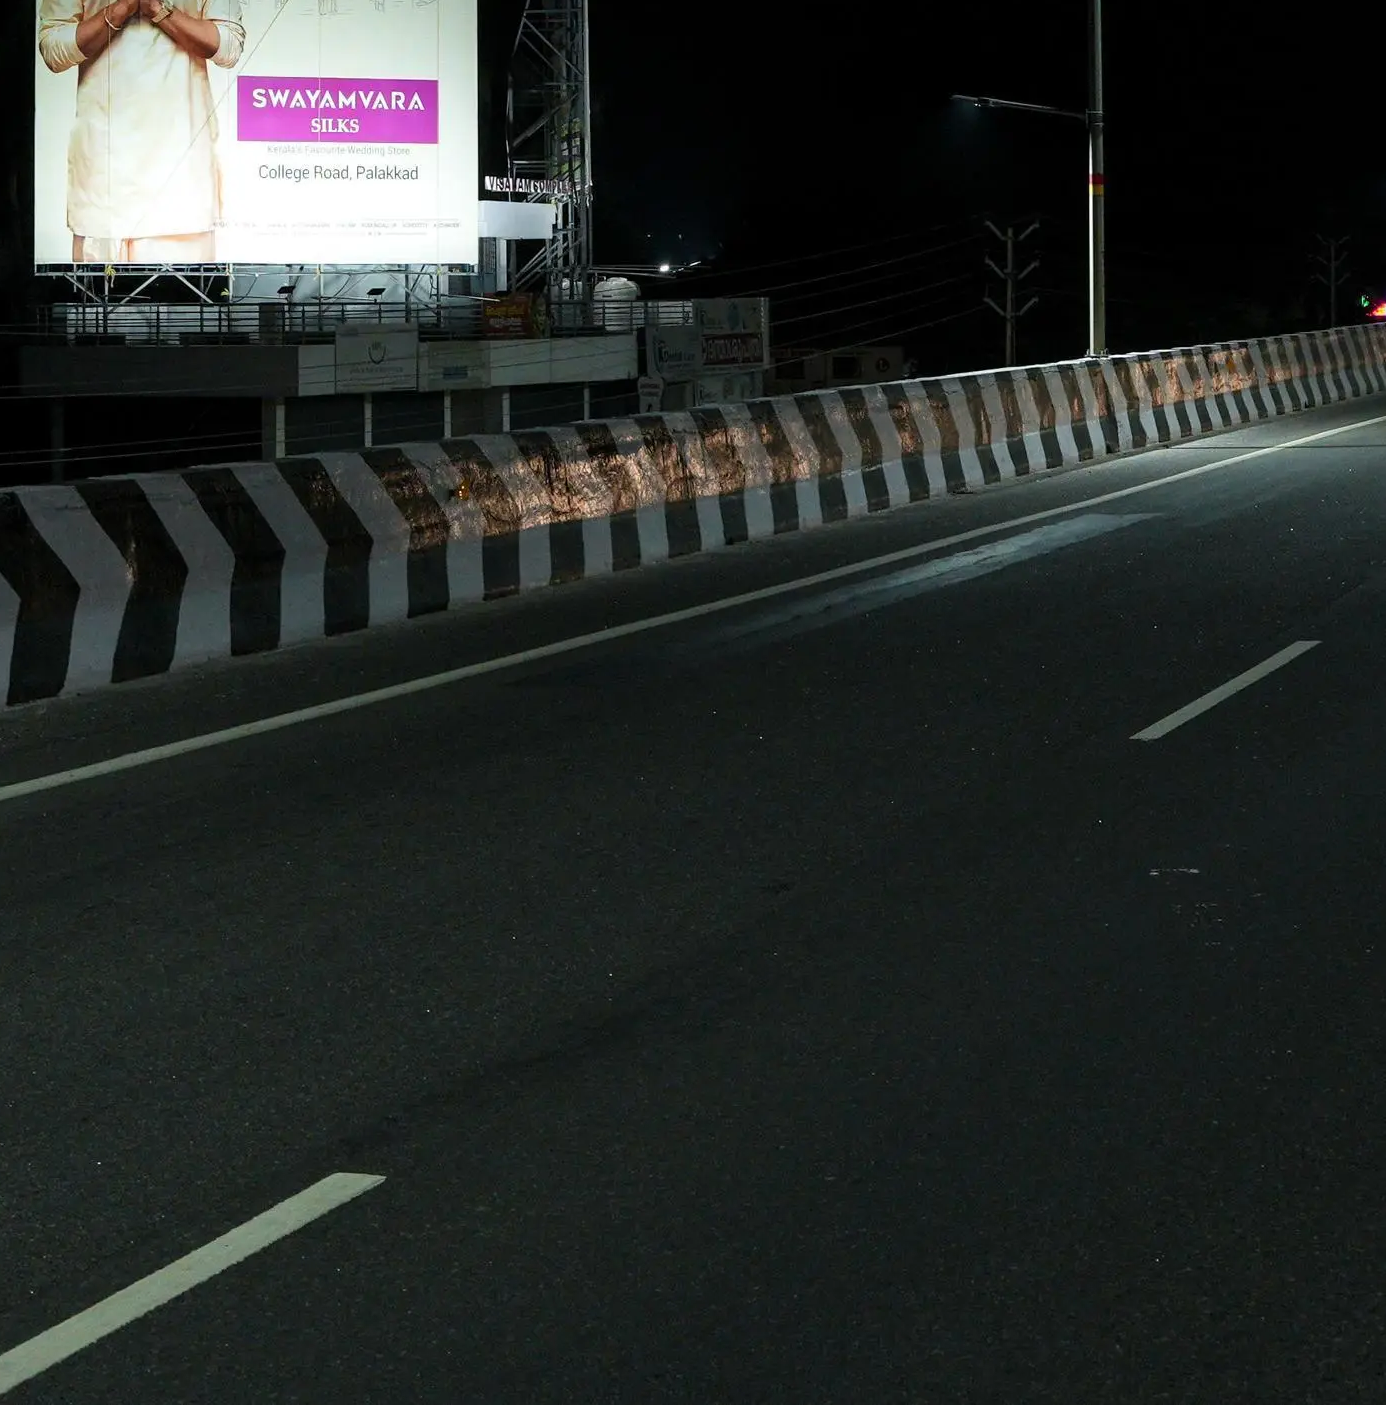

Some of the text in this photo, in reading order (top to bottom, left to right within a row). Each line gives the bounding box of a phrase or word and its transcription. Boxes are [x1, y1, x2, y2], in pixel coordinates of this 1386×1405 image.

[252, 88, 425, 111] SWAYAMVARA
[311, 118, 360, 134] SILKS
[347, 146, 385, 157] Wedding
[258, 165, 419, 183] College Road, Palakkad
